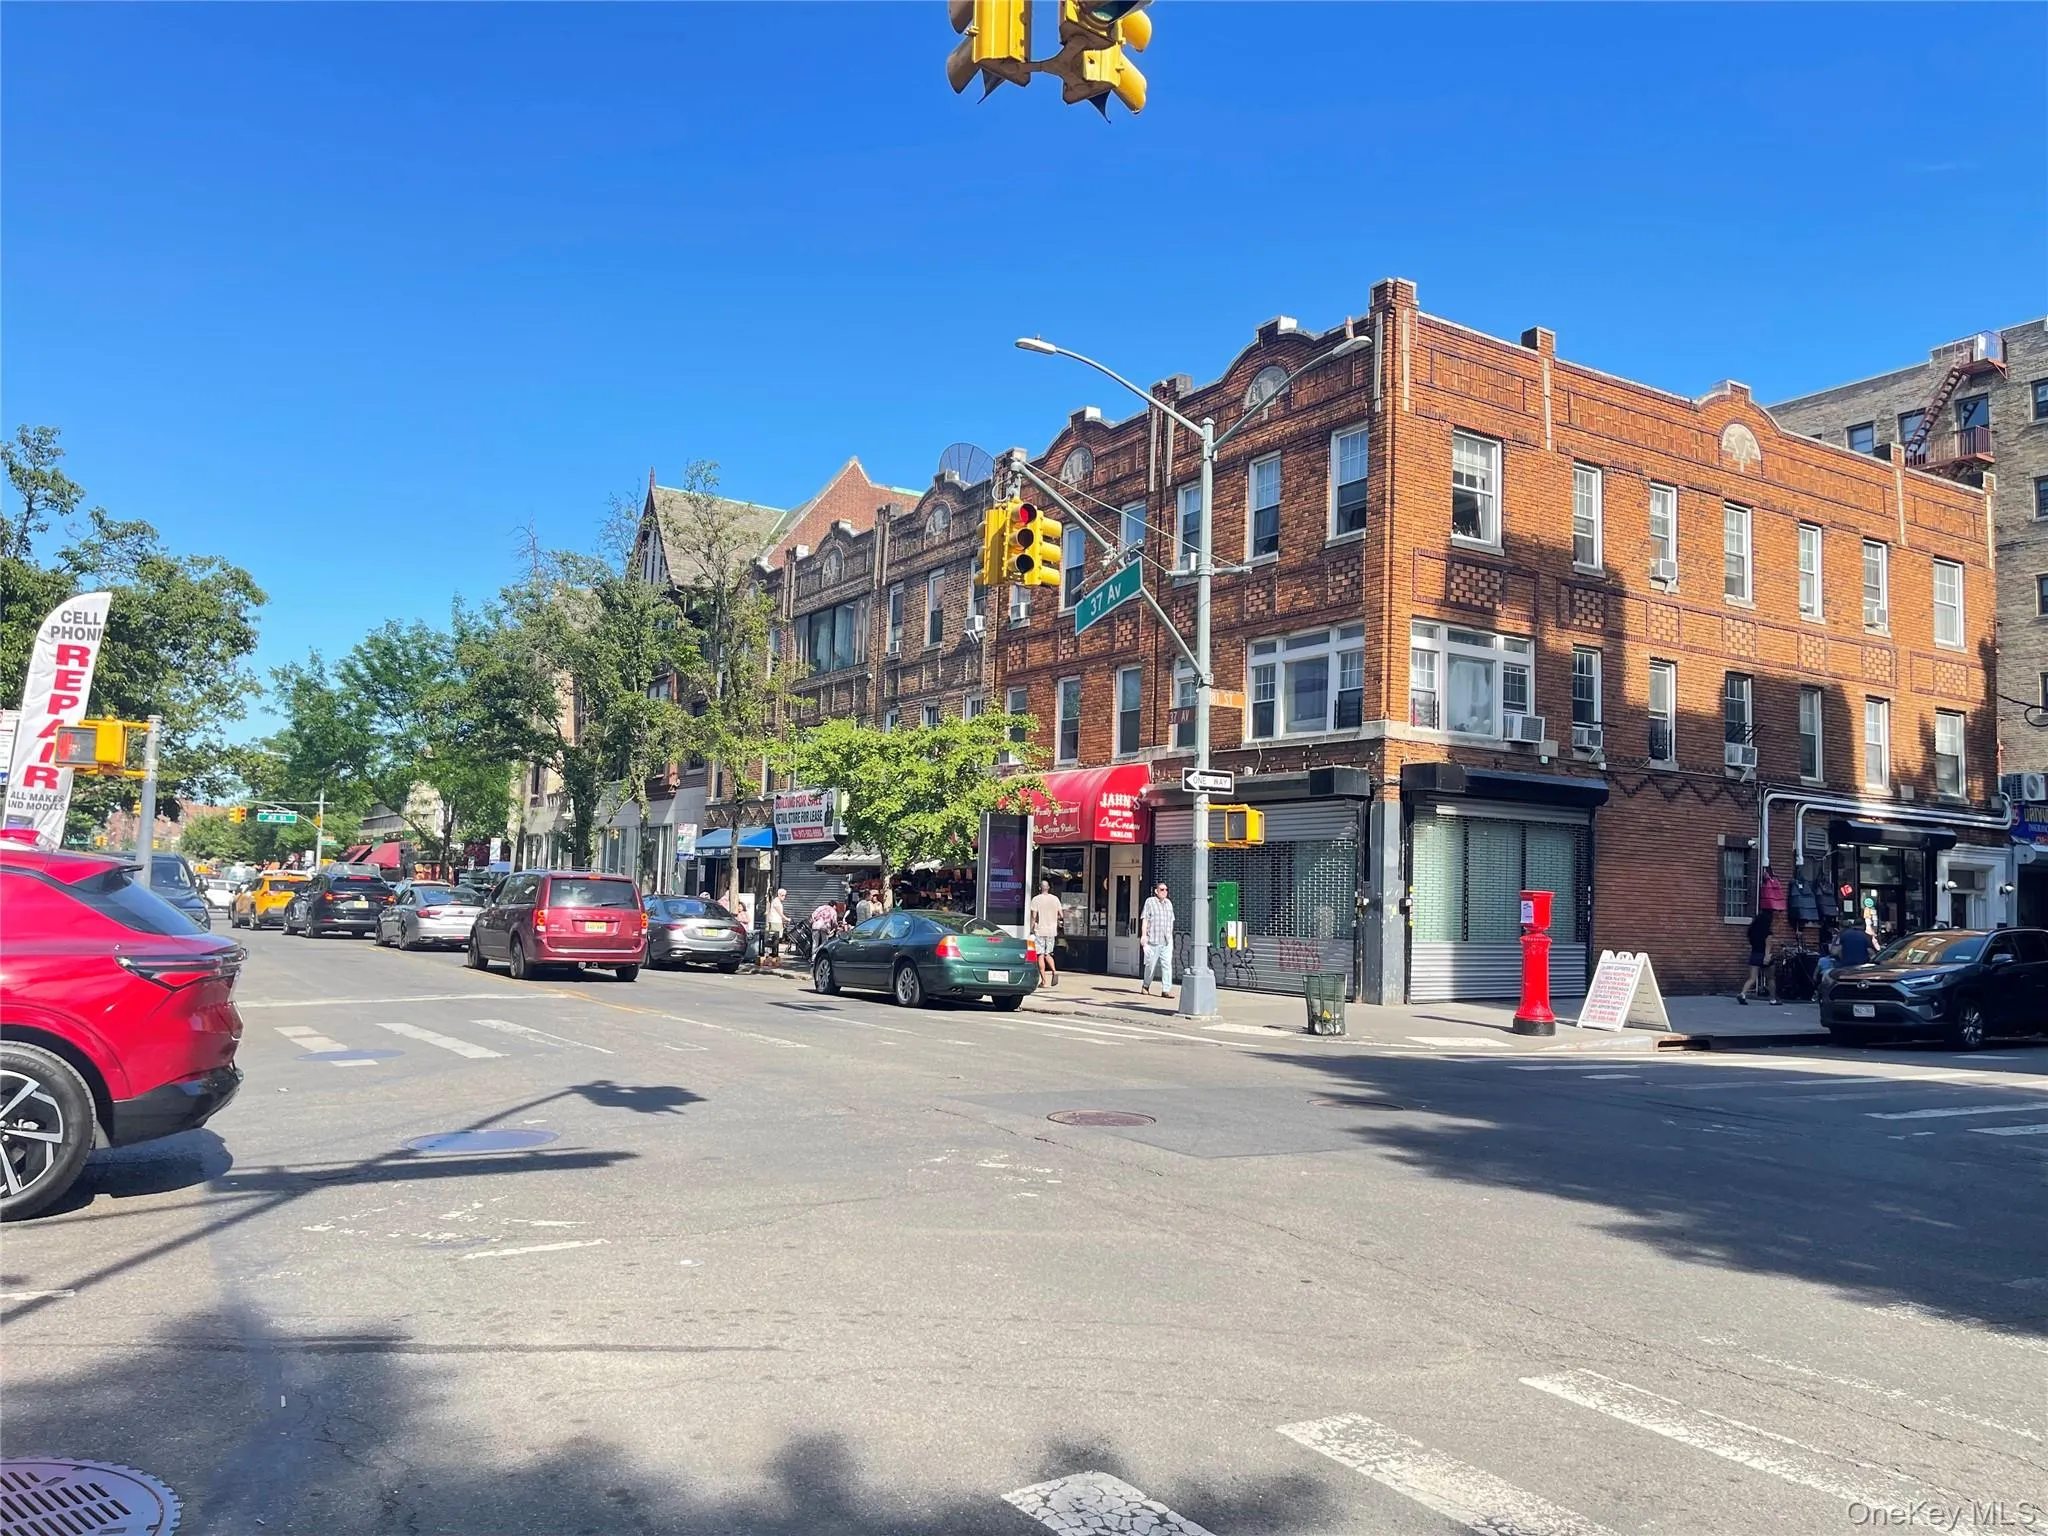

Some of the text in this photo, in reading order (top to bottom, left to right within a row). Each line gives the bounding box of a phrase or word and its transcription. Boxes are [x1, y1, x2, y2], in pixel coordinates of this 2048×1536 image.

[1090, 582, 1121, 617] 37 Av
[61, 610, 101, 625] CELL
[1224, 694, 1233, 705] ST
[1169, 709, 1190, 723] 37 AV
[1193, 776, 1228, 786] ONE WAY
[10, 790, 27, 800] ALL
[796, 795, 807, 808] FOR
[1099, 792, 1141, 810] JAHN'S
[776, 810, 822, 824] RETAIL STORE FOR LEASE
